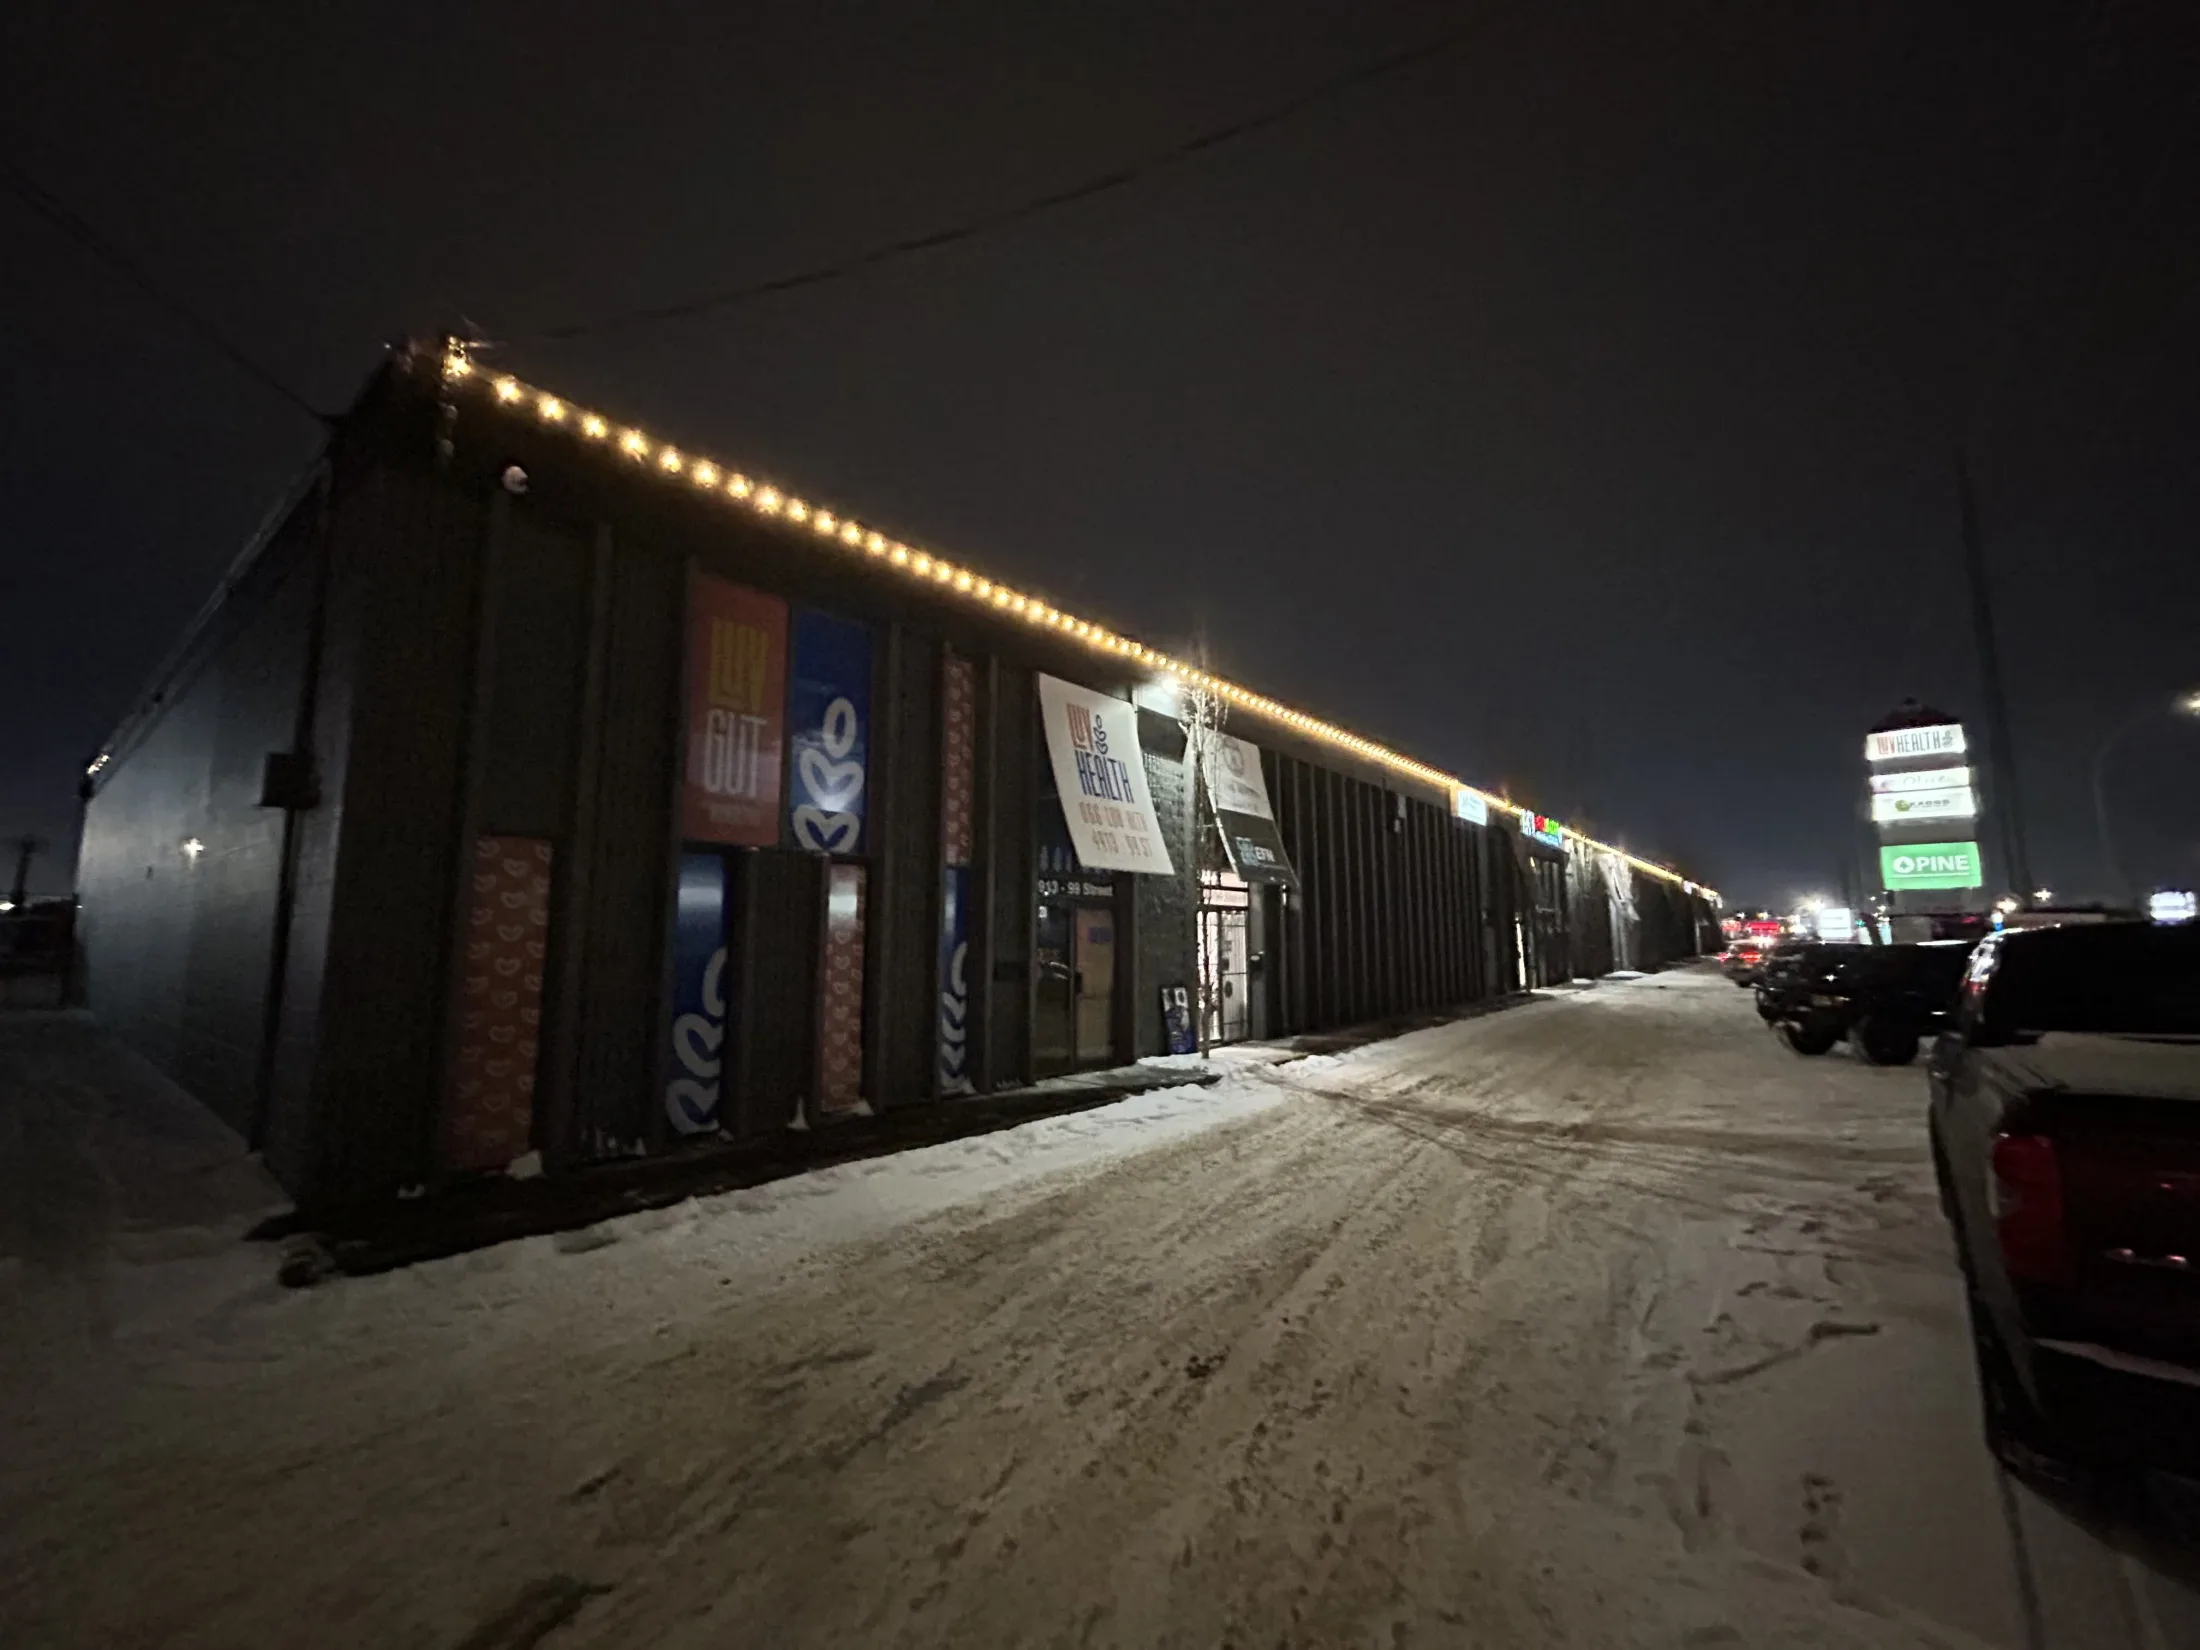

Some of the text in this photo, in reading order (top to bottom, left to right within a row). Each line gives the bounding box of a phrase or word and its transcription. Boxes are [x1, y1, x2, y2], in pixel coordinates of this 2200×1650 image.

[704, 707, 767, 797] GUT
[1066, 702, 1094, 752] LUV
[1074, 749, 1135, 804] HEALTH
[1915, 855, 1970, 873] PINE
